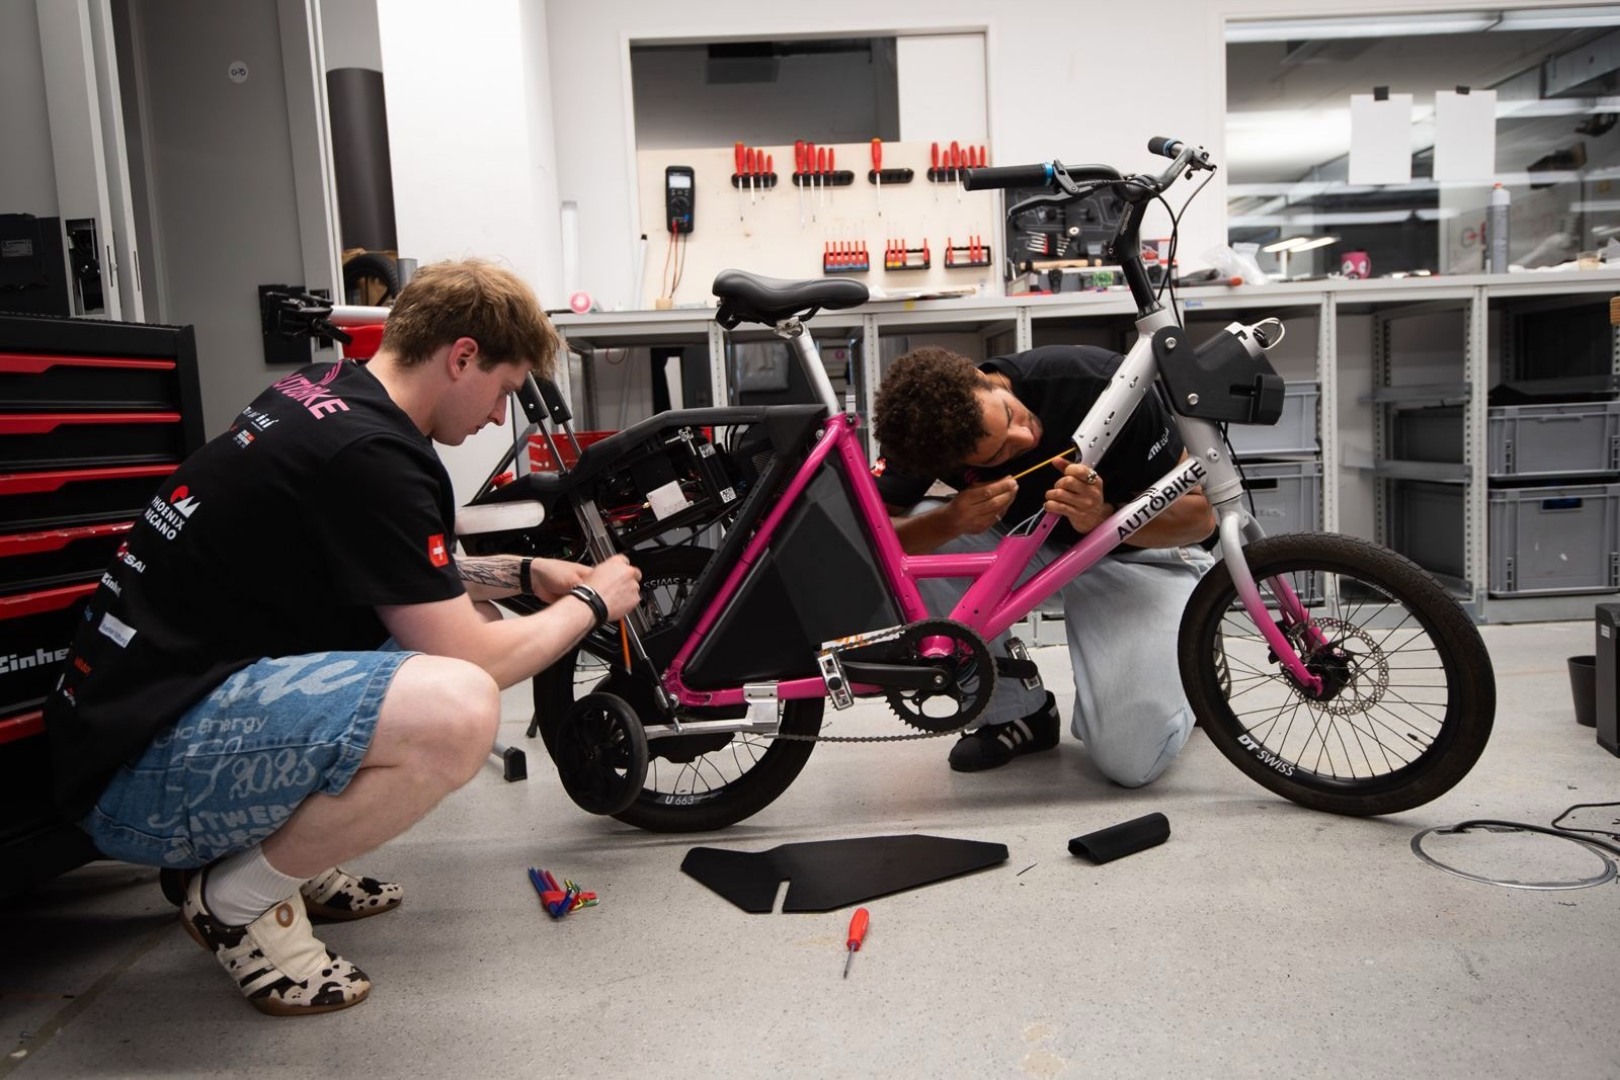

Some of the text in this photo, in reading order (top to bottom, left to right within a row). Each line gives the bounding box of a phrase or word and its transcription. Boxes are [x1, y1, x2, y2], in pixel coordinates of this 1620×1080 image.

[1117, 461, 1207, 540] AUTOBIKE
[0, 648, 70, 674] Einhe
[1237, 734, 1296, 777] DT SWISS
[675, 795, 695, 806] 663
